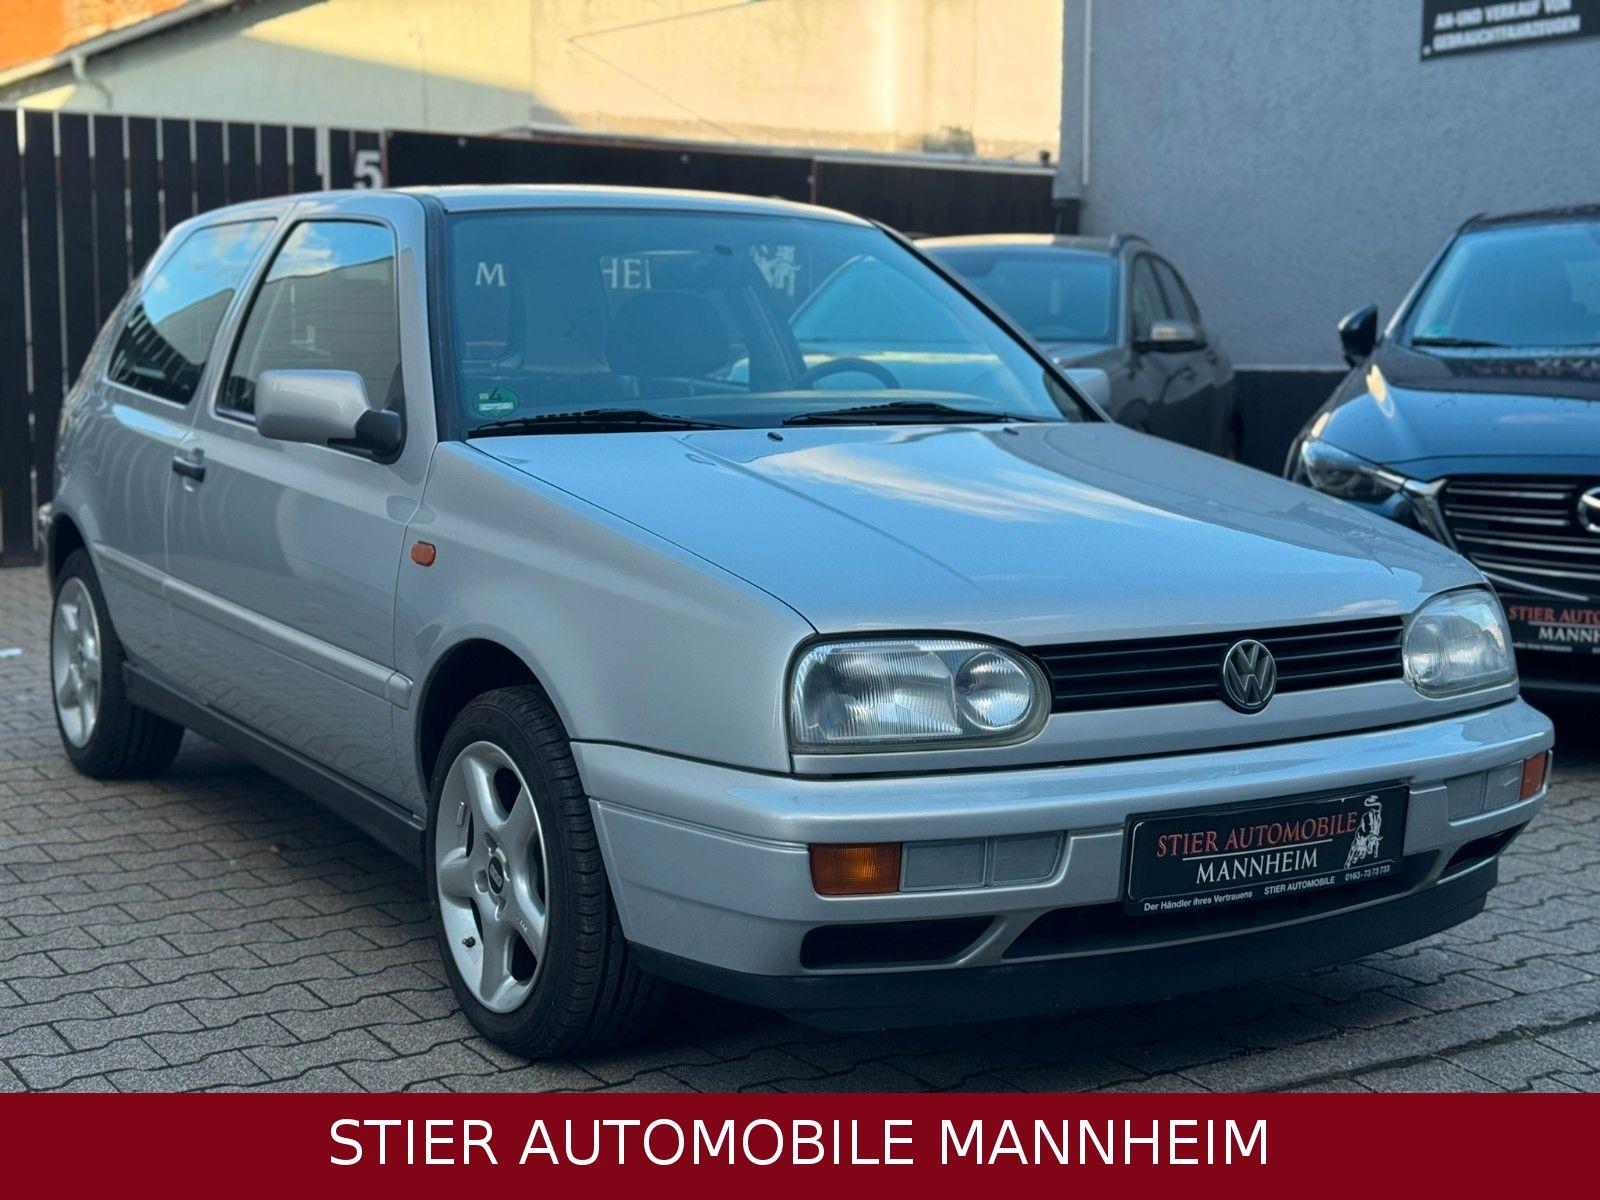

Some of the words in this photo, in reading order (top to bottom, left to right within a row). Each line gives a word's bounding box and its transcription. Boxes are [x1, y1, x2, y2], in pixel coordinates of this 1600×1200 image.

[1508, 605, 1556, 622] STIER
[1156, 830, 1218, 858] STIER
[1225, 811, 1358, 850] AUTOMOBILE
[1196, 848, 1318, 884] MANNHEIM
[1144, 902, 1159, 911] Der
[1161, 899, 1192, 909] Händler
[1213, 891, 1253, 903] Vertrauens
[1263, 884, 1286, 895] STIER
[1287, 875, 1336, 892] AUTOMOBILE
